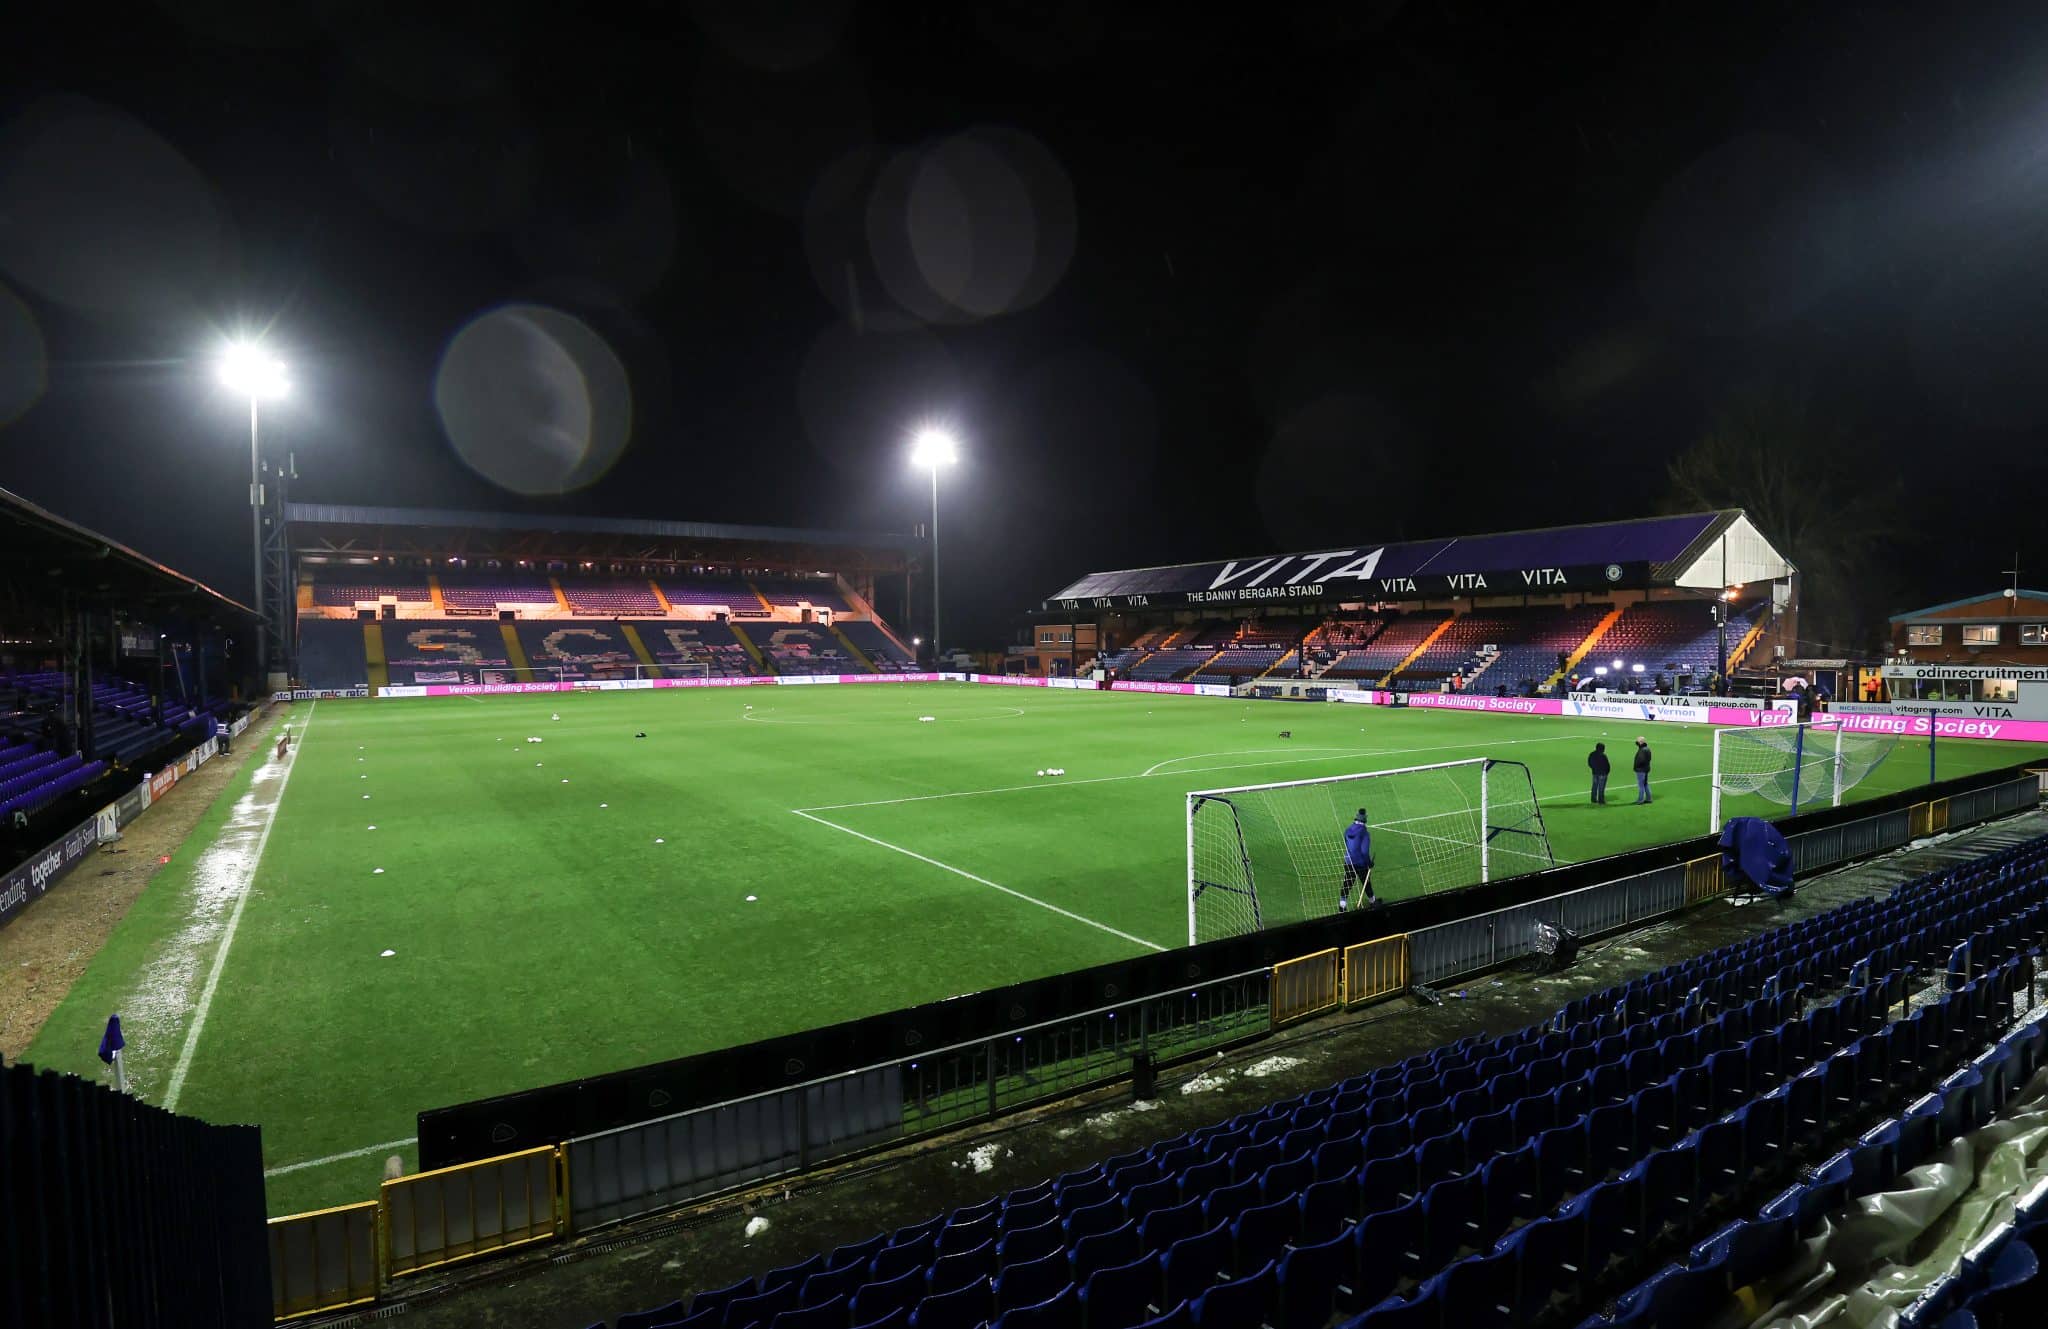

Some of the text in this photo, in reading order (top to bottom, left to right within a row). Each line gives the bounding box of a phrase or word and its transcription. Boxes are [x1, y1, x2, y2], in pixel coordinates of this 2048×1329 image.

[1209, 547, 1384, 589] VITA
[1447, 574, 1487, 589] VITA
[1521, 568, 1567, 585] VITA
[1381, 578, 1416, 592] VITA
[1187, 585, 1323, 602] THE DANNY BERGARA STAND
[1061, 600, 1079, 610] VITA
[1093, 598, 1112, 608] VITA
[1127, 596, 1148, 606] VITA
[346, 689, 365, 697] mtc
[448, 682, 557, 693] Vernon Building Society
[1157, 683, 1183, 693] Society
[1438, 695, 1485, 709] Building
[1489, 698, 1536, 712] Society
[1571, 694, 1758, 709] VITA vitagroup.com VITA vitagroup.com
[1589, 704, 1624, 712] Vernon
[1658, 707, 1696, 717] Vernon
[1896, 705, 2013, 718] vitagrop.com VITA
[1914, 717, 2001, 739] Society
[65, 833, 82, 861] Family
